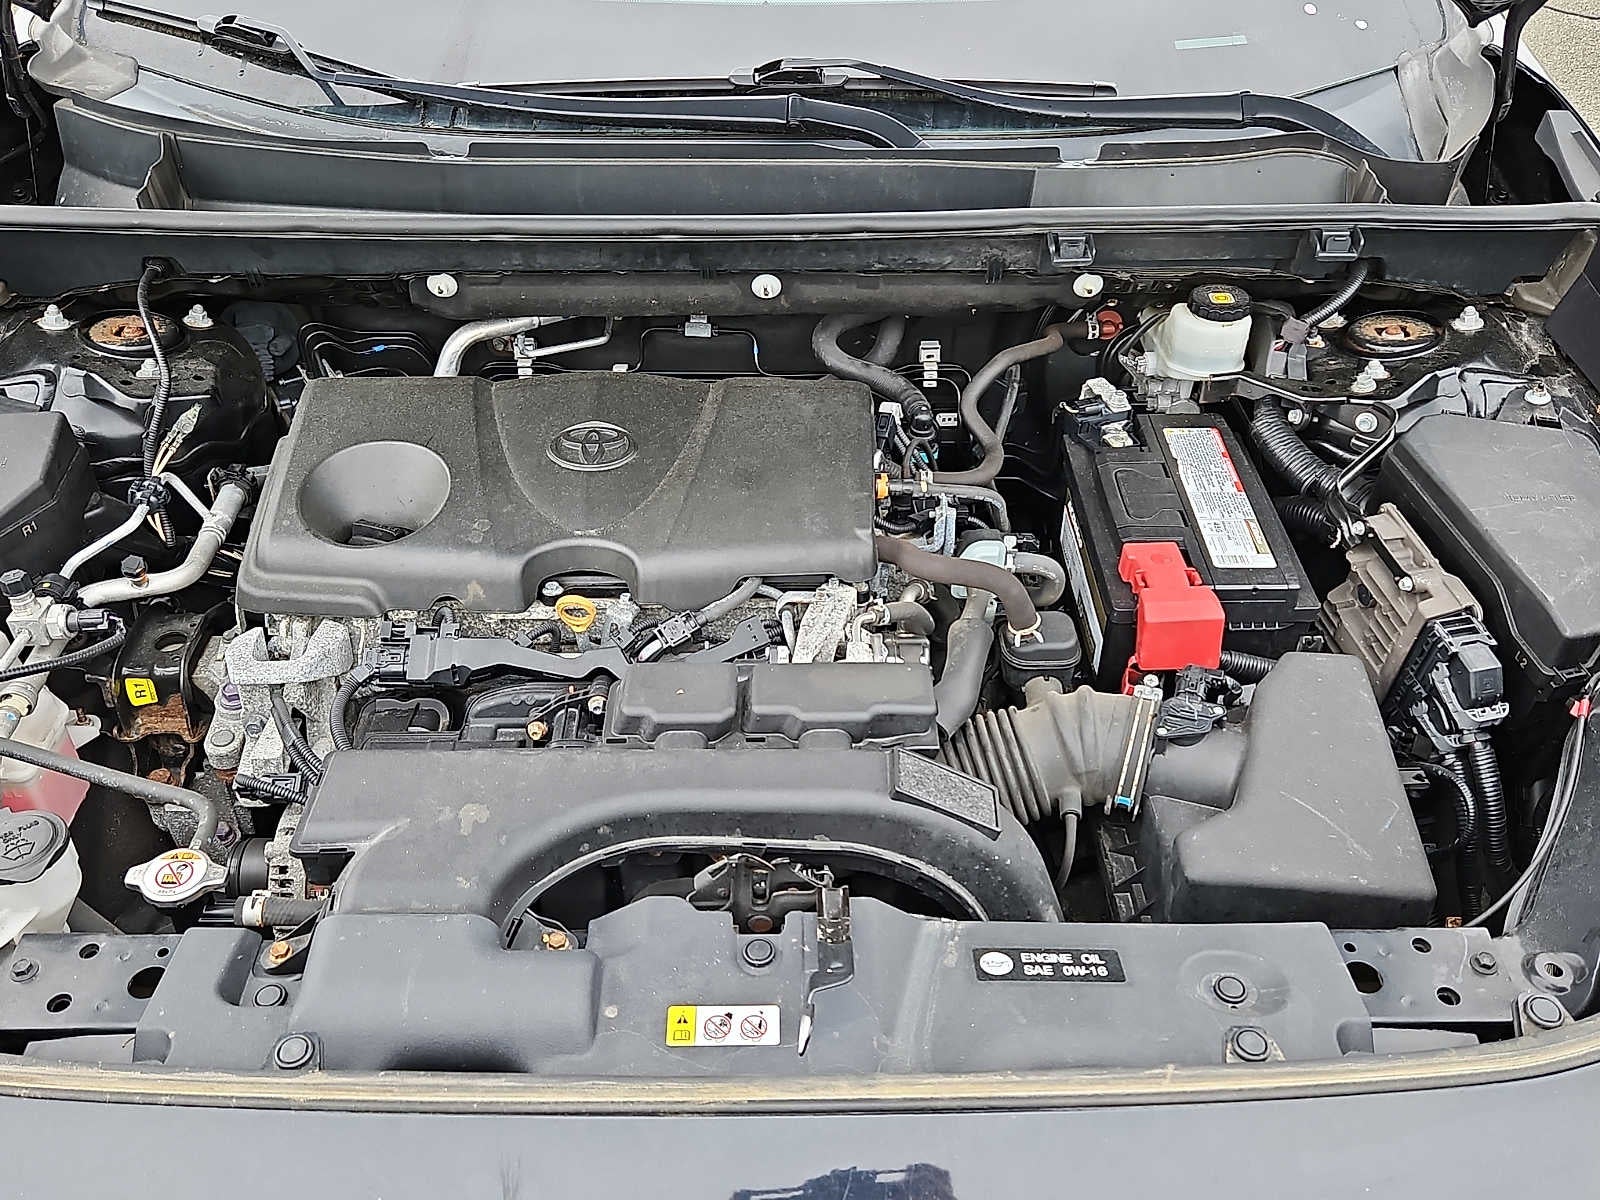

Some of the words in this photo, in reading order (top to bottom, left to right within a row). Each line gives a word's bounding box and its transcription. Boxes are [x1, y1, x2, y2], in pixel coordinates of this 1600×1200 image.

[21, 520, 38, 537] R1
[132, 683, 147, 698] R1
[1020, 952, 1073, 964] ENGINE
[1080, 953, 1106, 964] OIL
[1023, 965, 1054, 976] SAE
[1062, 965, 1109, 977] 0W-16
